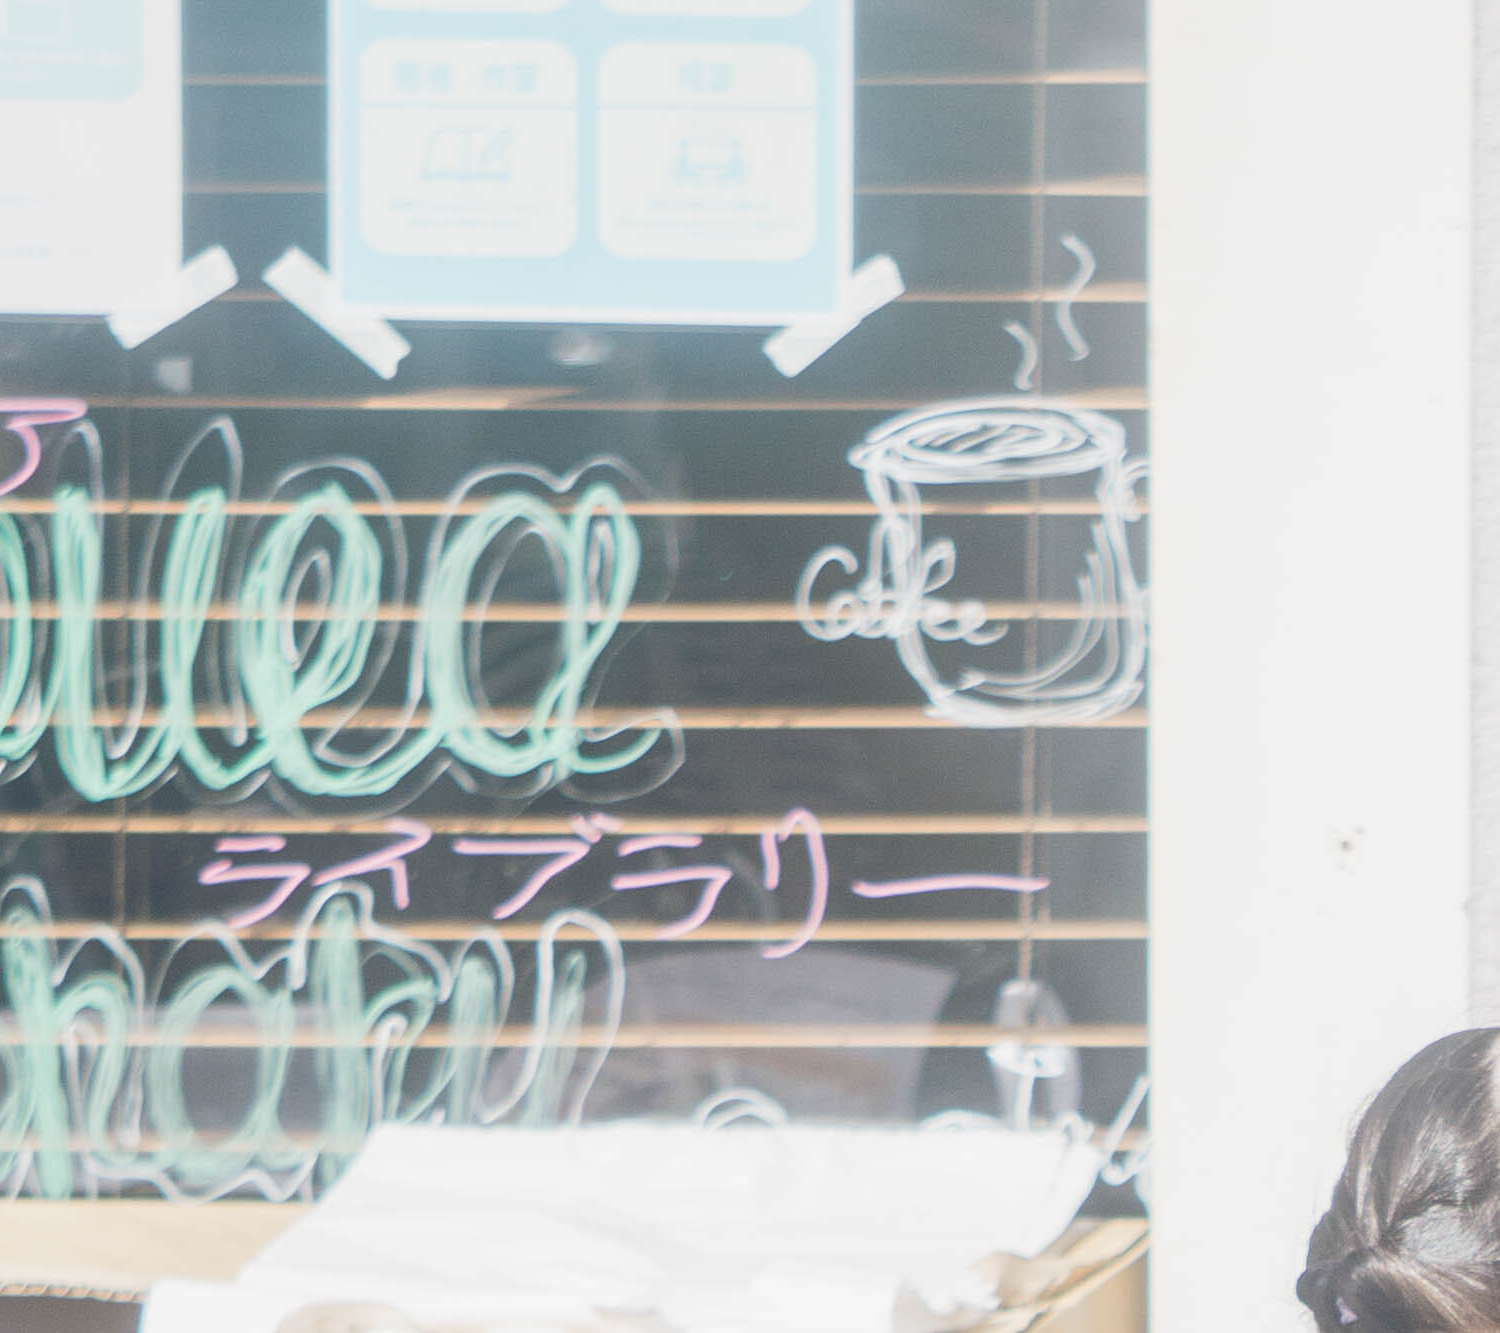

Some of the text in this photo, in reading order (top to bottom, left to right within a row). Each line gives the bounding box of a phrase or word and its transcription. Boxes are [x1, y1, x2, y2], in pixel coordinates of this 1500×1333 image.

[199, 808, 1050, 959] ライブラリー
